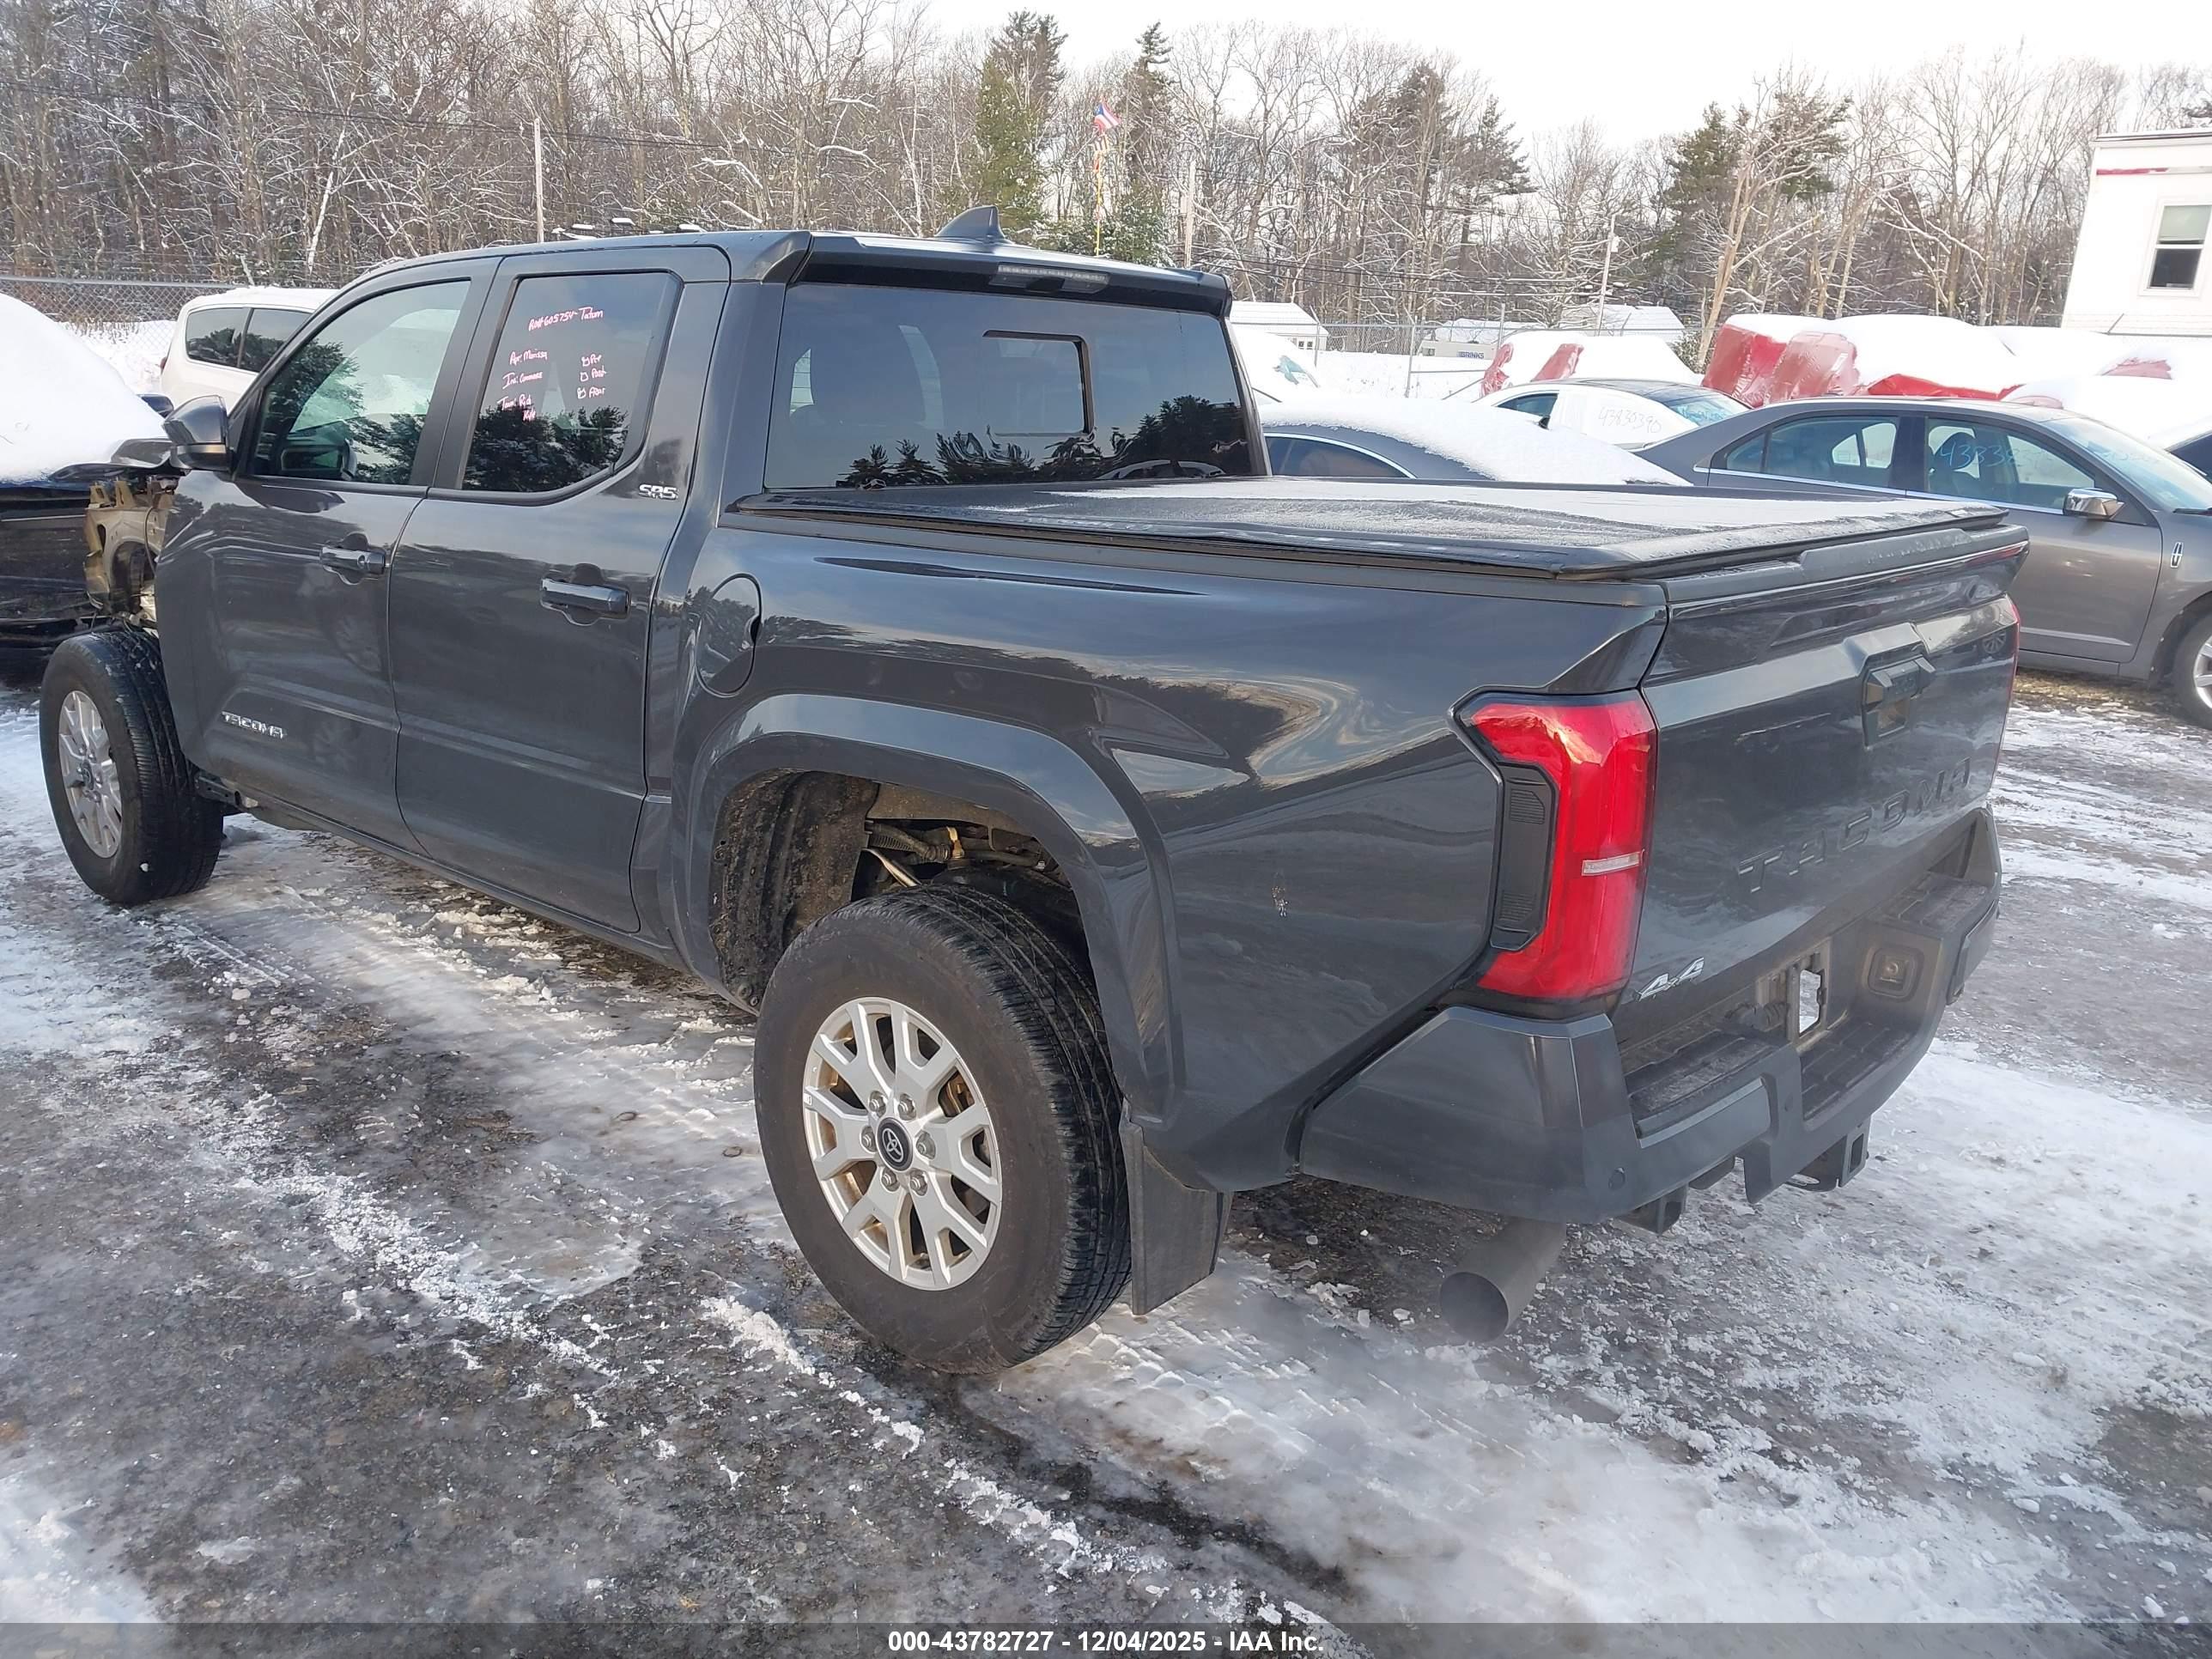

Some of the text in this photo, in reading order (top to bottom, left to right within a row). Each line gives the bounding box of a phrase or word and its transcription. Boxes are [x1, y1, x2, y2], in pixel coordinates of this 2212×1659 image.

[639, 483, 678, 500] SR5
[222, 711, 284, 739] TACOMA
[1737, 756, 1972, 894] TACOMA
